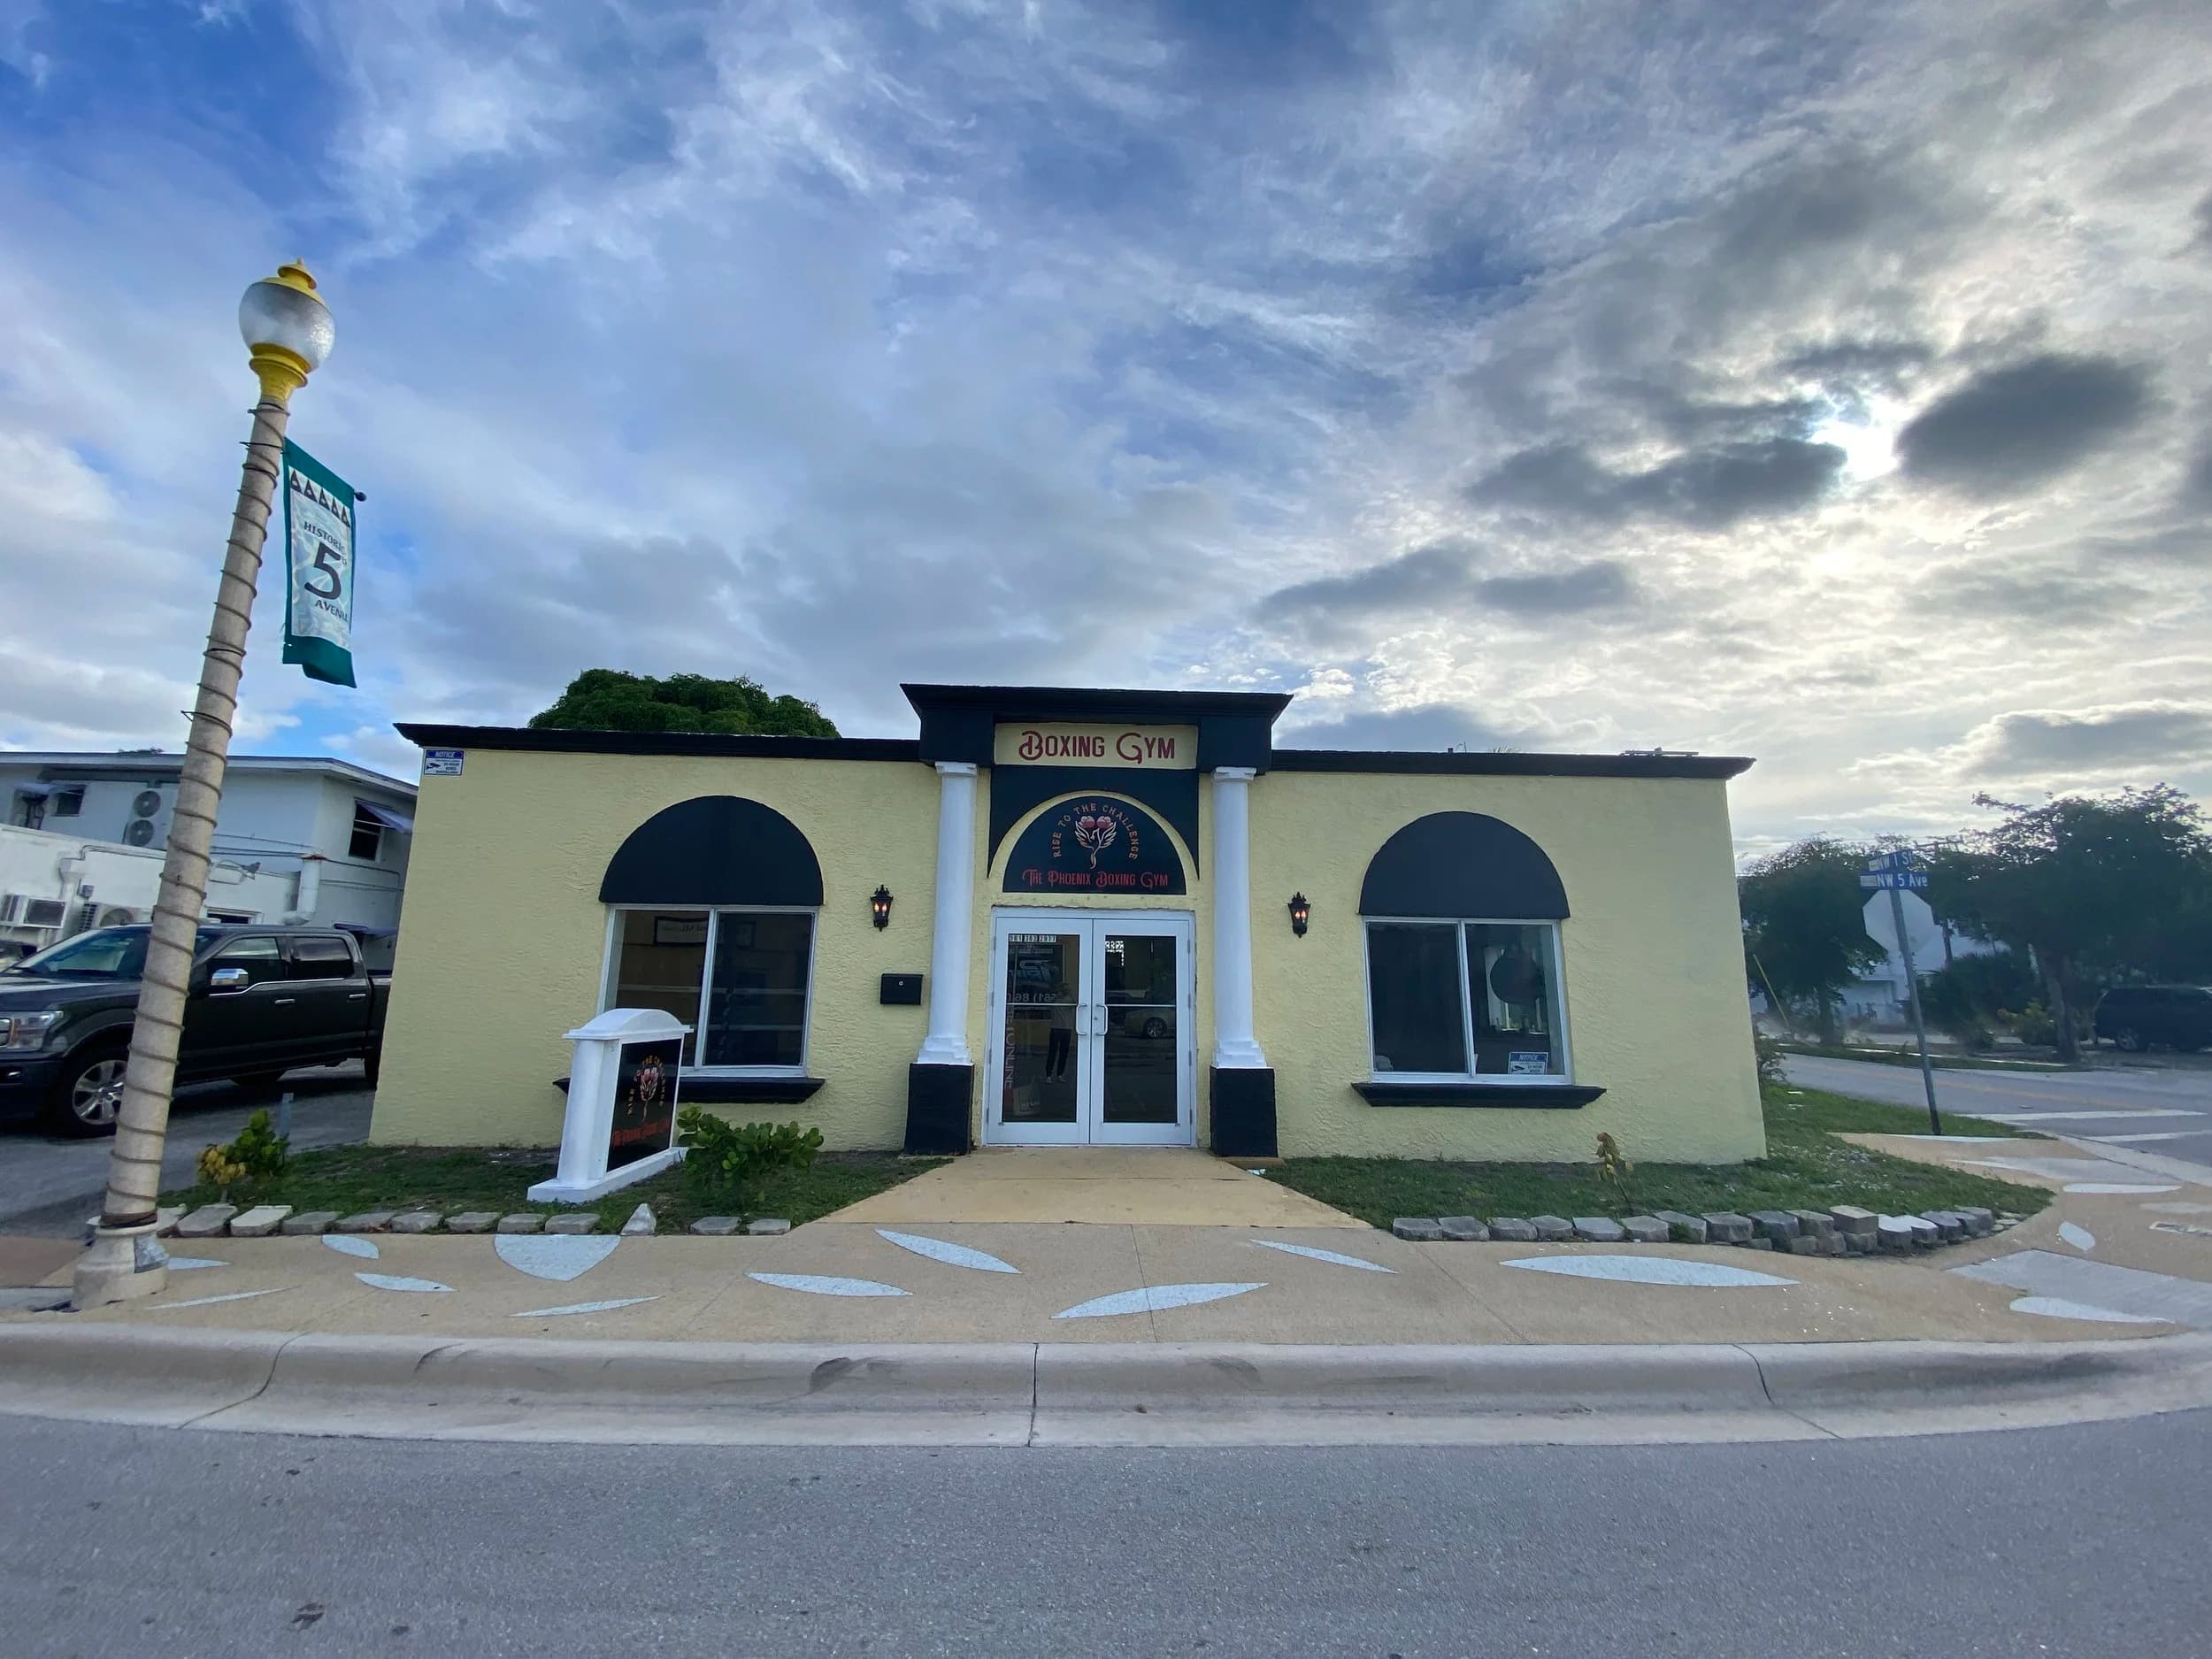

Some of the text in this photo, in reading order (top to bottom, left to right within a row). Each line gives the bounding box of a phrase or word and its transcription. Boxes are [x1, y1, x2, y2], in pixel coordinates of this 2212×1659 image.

[1051, 803, 1140, 860] RISE TO THE CHALLENGE
[1877, 873, 1893, 887] NW
[1898, 873, 1905, 887] 5
[1909, 873, 1929, 887] Ave
